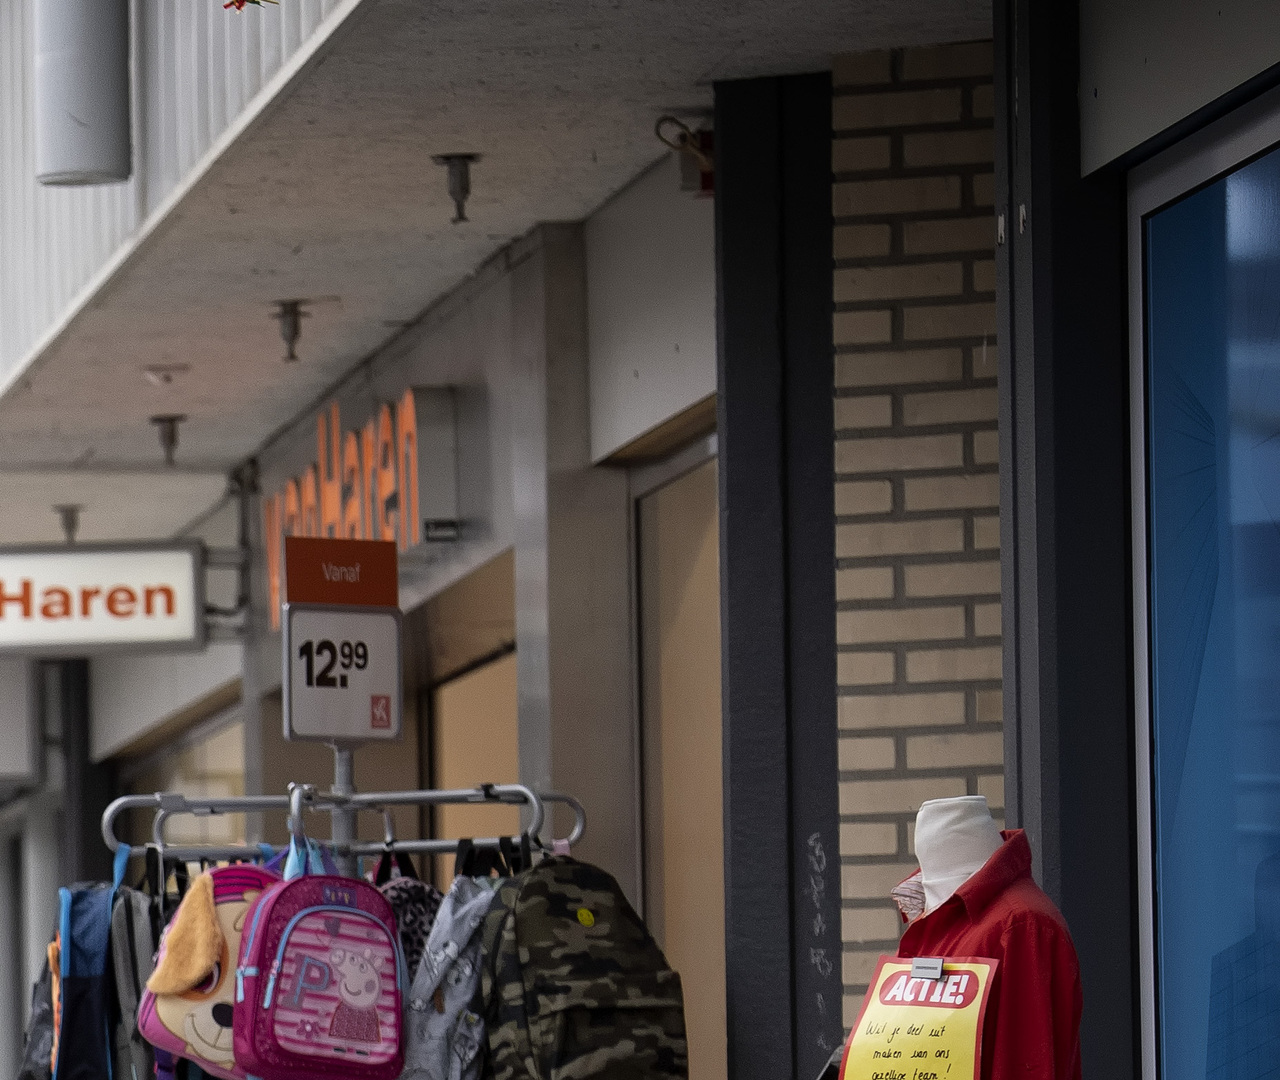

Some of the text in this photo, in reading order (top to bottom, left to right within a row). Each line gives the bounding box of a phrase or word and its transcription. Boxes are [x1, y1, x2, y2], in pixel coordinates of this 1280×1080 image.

[322, 562, 361, 583] Vanaf
[298, 639, 369, 689] 12.99
[884, 974, 970, 1006] ACTIE!
[872, 1048, 951, 1060] maken van ons
